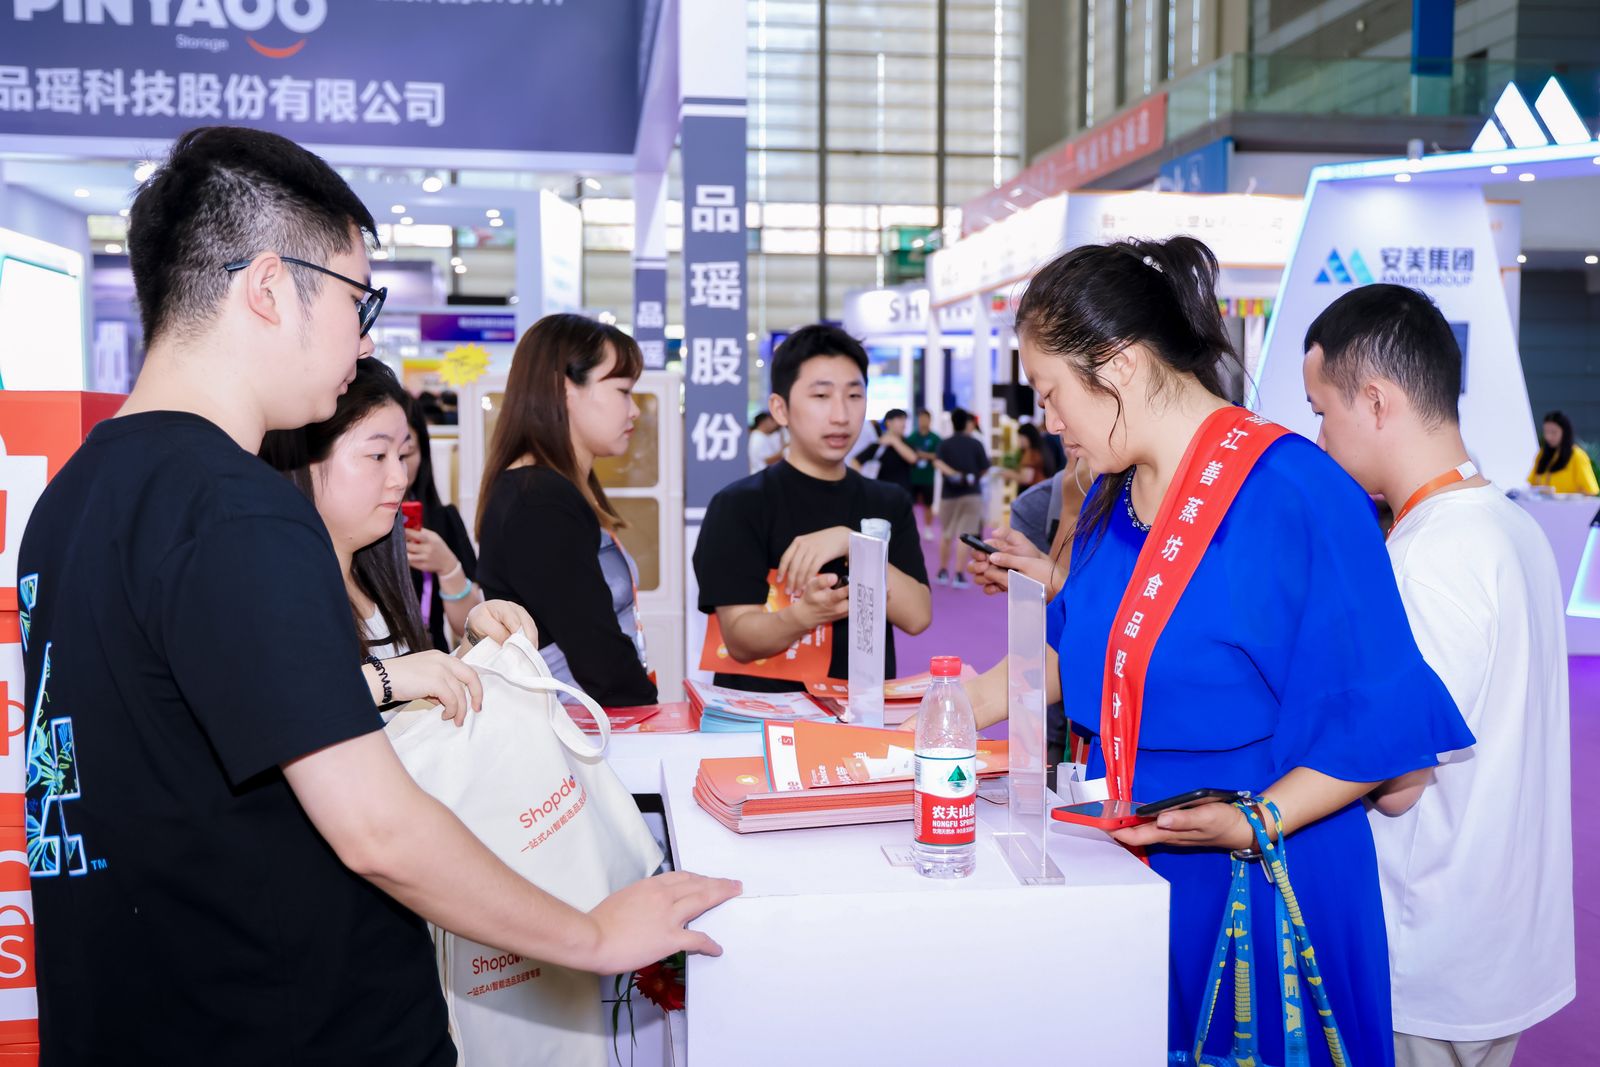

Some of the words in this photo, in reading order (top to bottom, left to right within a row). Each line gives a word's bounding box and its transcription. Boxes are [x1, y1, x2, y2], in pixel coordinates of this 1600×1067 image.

[175, 34, 229, 53] Storage
[0, 65, 446, 127] 品瑶科技股份有限公司
[1381, 248, 1474, 272] 安美集团
[691, 184, 743, 462] 品瑶股份
[91, 858, 108, 870] TM
